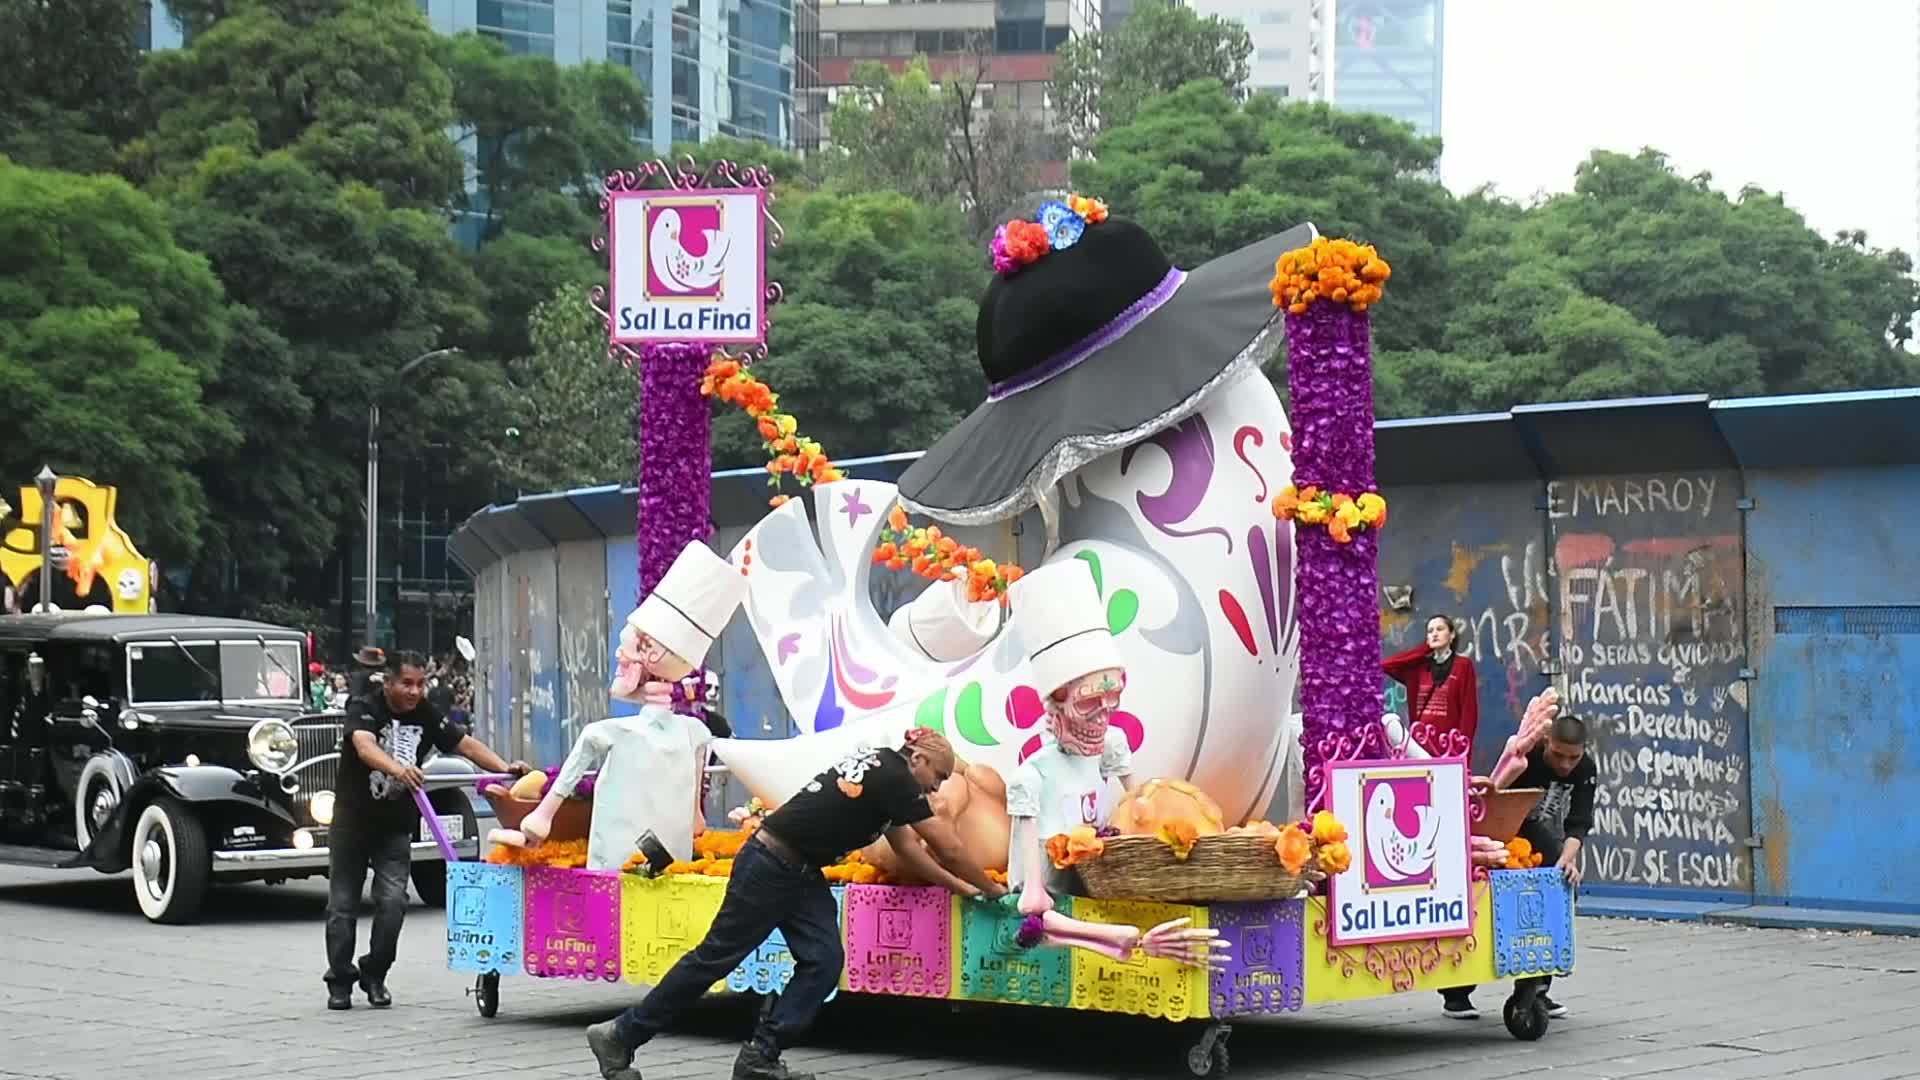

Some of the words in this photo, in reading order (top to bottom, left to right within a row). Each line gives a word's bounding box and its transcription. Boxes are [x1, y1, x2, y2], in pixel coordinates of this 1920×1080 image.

[620, 307, 656, 330] Sal
[664, 308, 692, 330] La
[699, 307, 751, 330] Fina
[1559, 642, 1583, 665] NO
[1341, 900, 1376, 931] Sal
[1383, 899, 1410, 926] La
[1415, 896, 1463, 924] Fina
